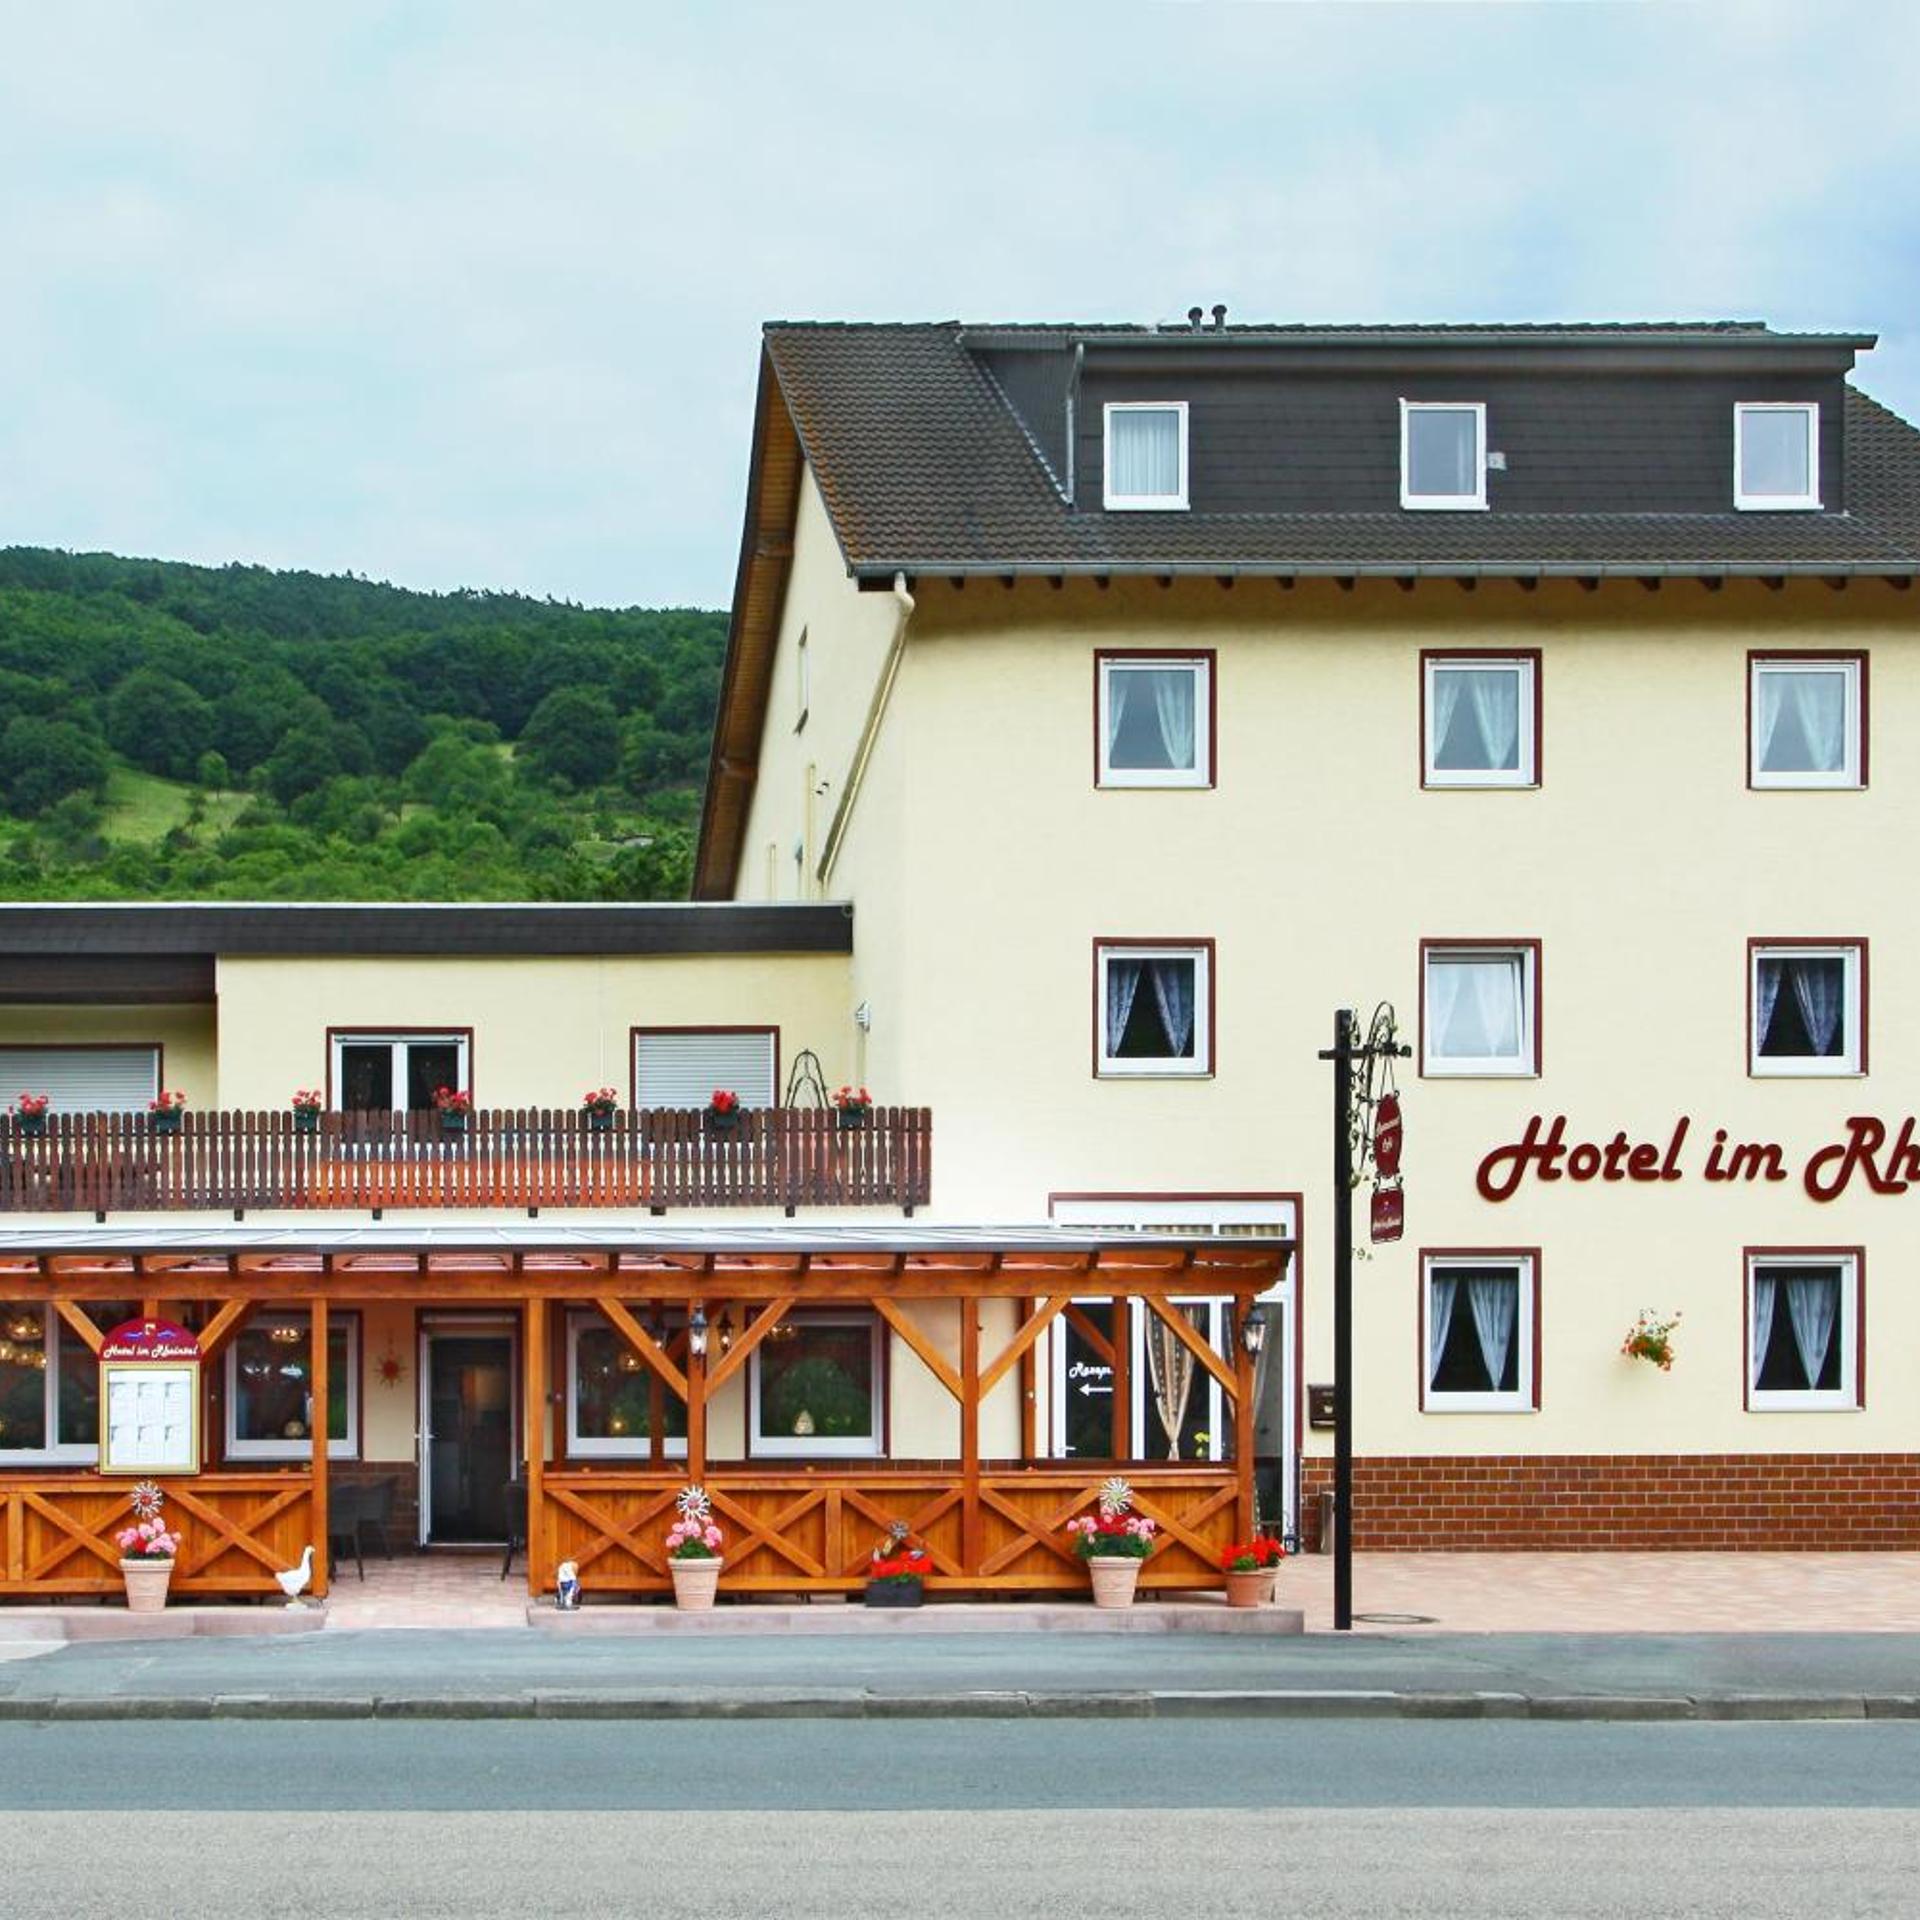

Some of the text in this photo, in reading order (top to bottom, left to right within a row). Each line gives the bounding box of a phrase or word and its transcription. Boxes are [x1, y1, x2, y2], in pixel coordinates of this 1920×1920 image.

[1476, 1115, 1690, 1201] Hotel
[1704, 1129, 1788, 1181] im
[103, 1344, 135, 1358] Hotel
[136, 1344, 150, 1356] im
